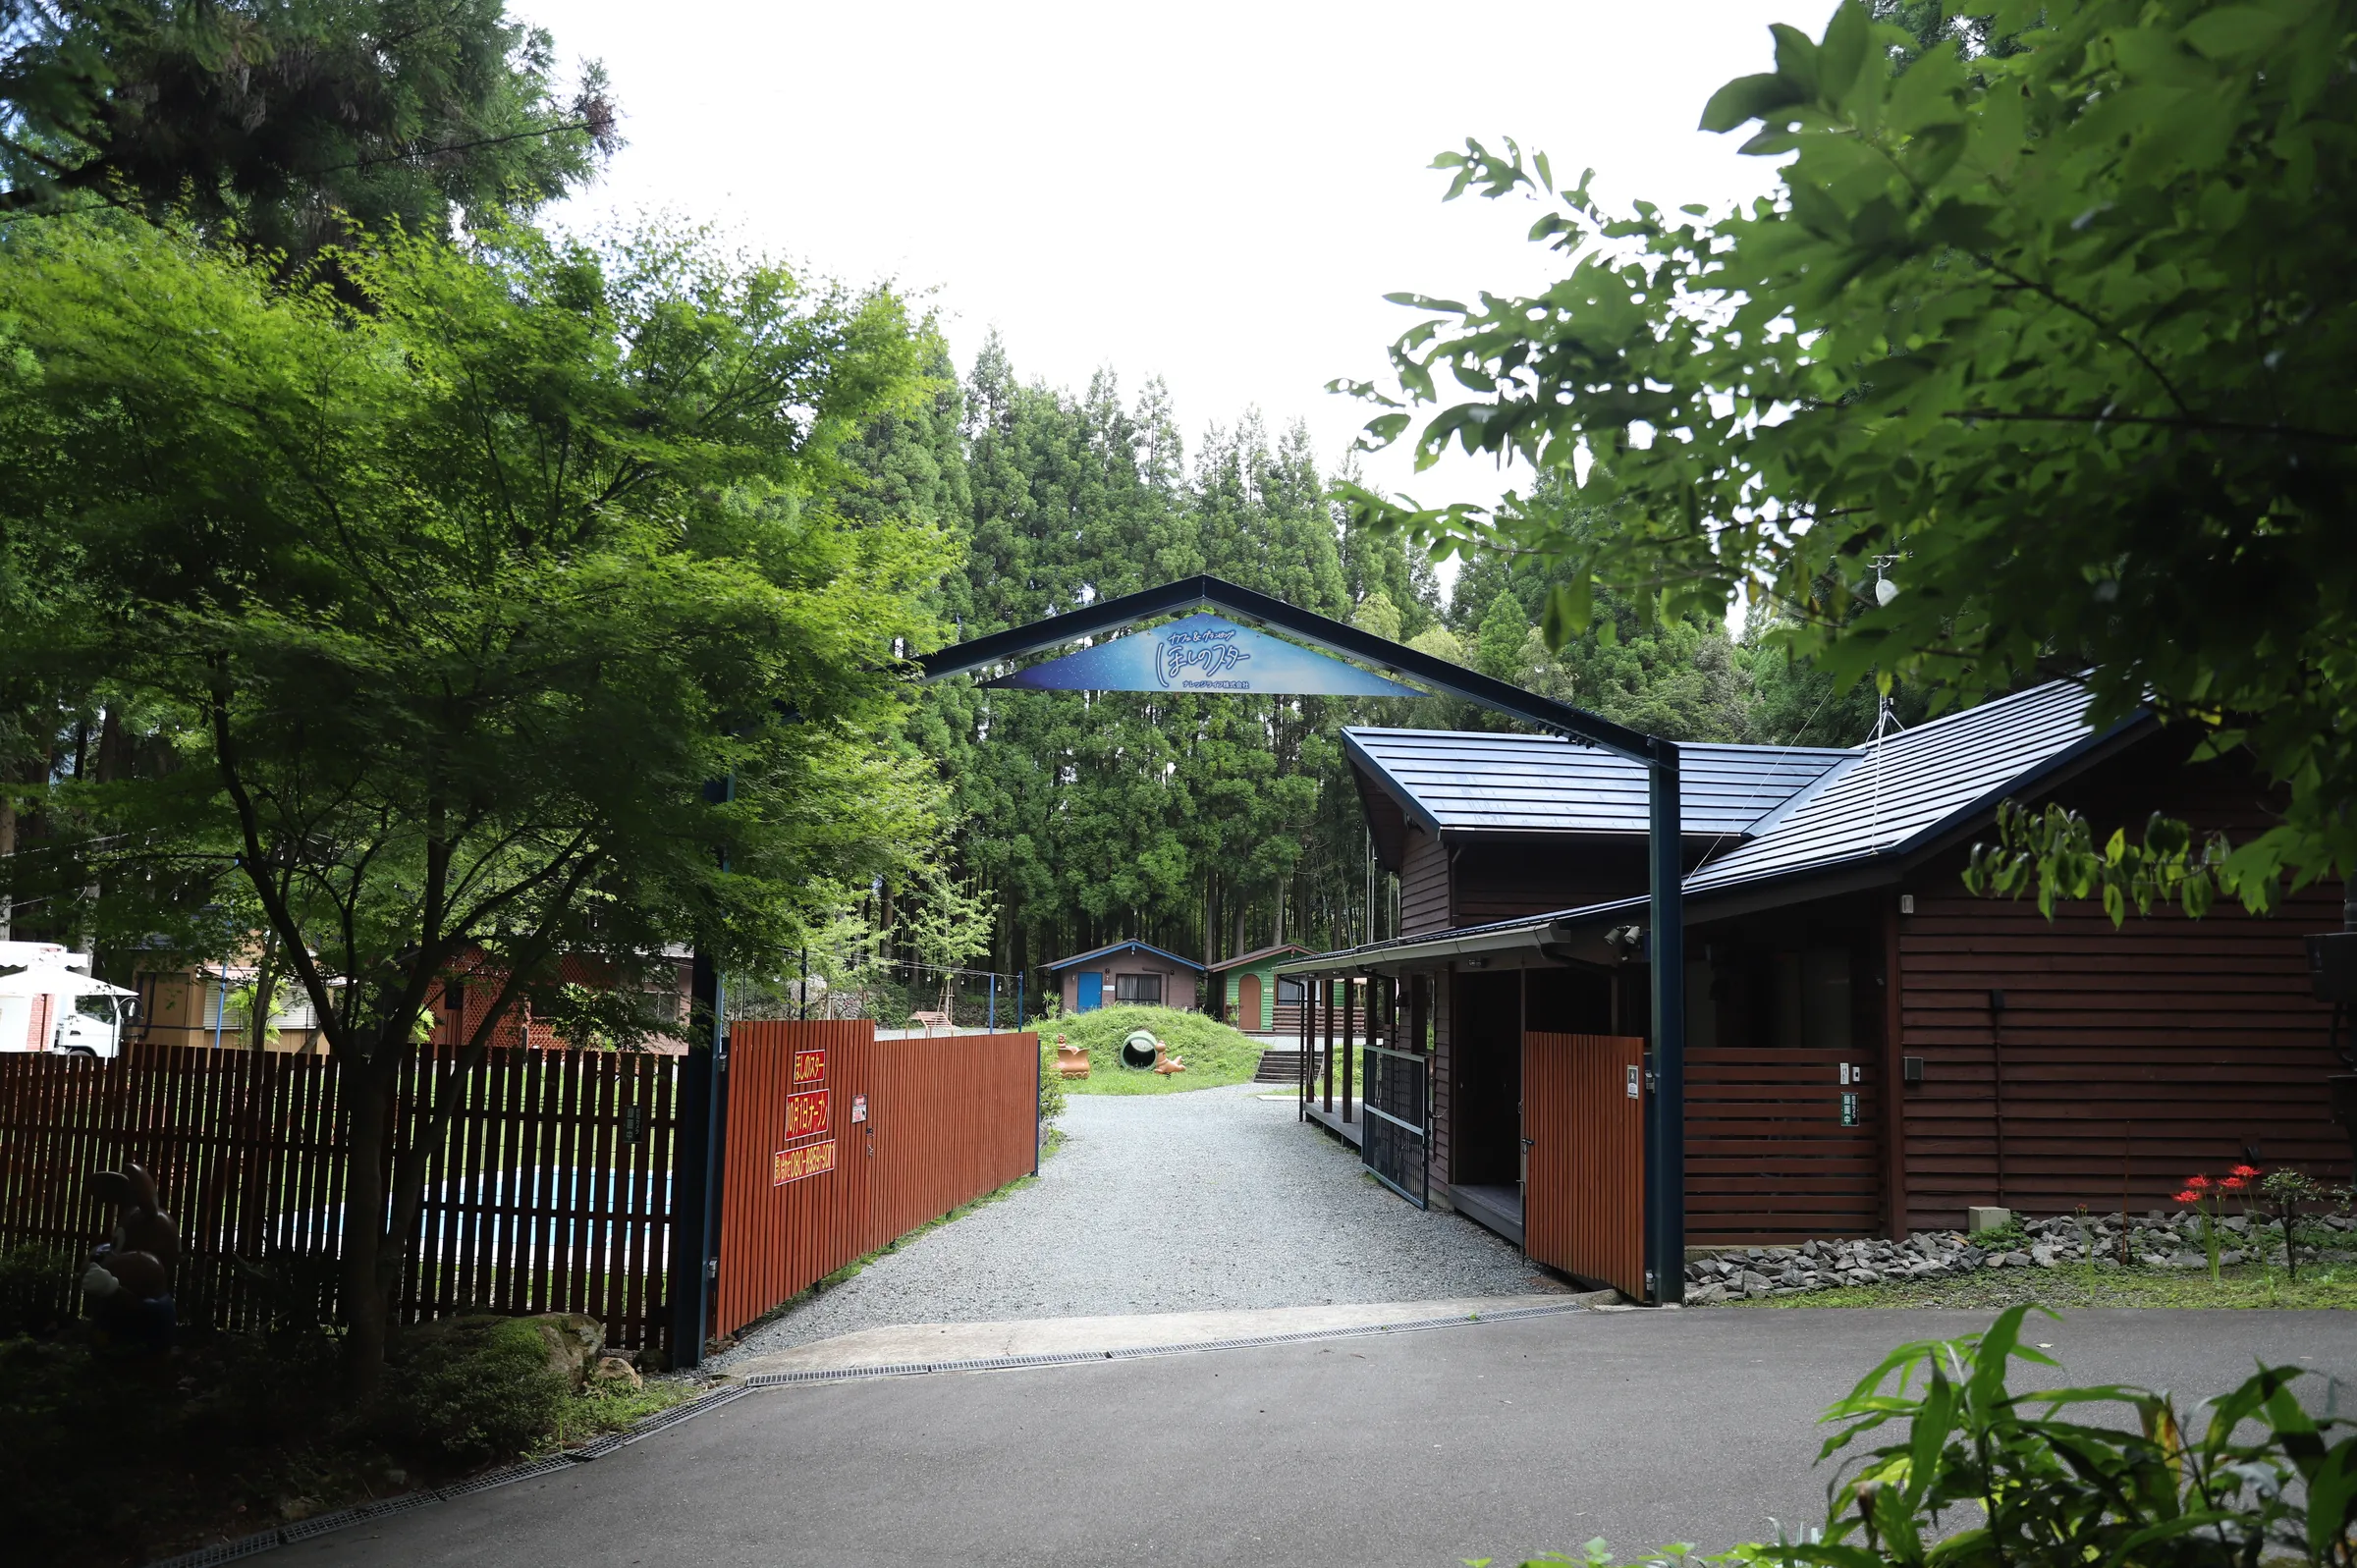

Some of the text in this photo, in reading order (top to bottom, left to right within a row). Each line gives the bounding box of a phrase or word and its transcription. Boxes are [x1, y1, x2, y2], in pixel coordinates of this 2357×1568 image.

[1155, 643, 1251, 687] ほしのスター
[795, 1054, 824, 1081] ほしのスター
[787, 1094, 828, 1134] 10月1日オープン
